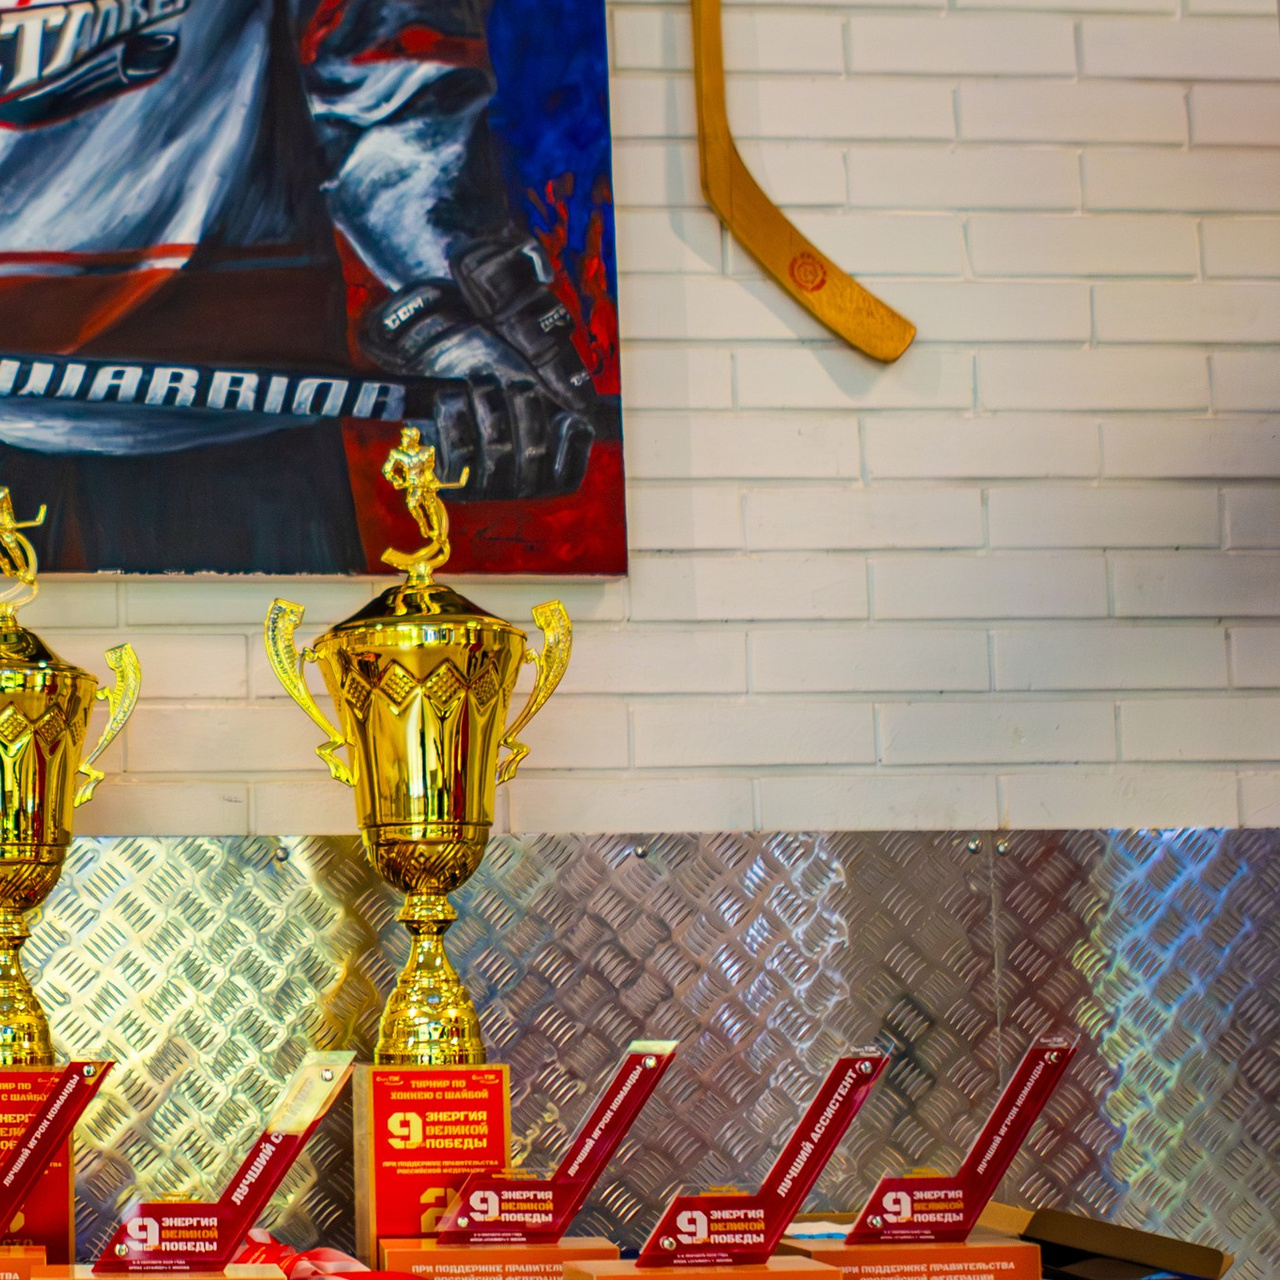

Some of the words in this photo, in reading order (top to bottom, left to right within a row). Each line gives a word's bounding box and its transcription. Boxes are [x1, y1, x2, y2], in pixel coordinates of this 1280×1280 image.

[18, 1082, 32, 1090] ПО
[410, 1080, 450, 1088] ТУРНИР
[452, 1079, 466, 1088] ПО
[390, 1091, 434, 1100] ХОККЕЮ
[444, 1089, 489, 1099] ШАЙБОЙ
[2, 1147, 32, 1187] ЛУЧШИЙ
[27, 1118, 51, 1151] ИГРОК
[45, 1074, 80, 1121] КОМАНДЫ
[387, 1111, 423, 1150] 9
[425, 1110, 488, 1122] ЭНЕРГИЯ
[425, 1122, 489, 1136] ВЕЛИКОЙ
[776, 1139, 815, 1198] ЛУЧШИЙ
[813, 1068, 858, 1144] АССИСТЕНТ
[425, 1137, 488, 1150] ПОБЕДЫ
[230, 1141, 277, 1206] ЛУЧШИЙ
[469, 1190, 500, 1222] 9
[501, 1190, 554, 1200] ЭНЕРГИЯ
[881, 1190, 912, 1224] 9
[913, 1189, 964, 1200] ЭНЕРГИЯ
[501, 1212, 554, 1223] ПОБЕДЫ
[913, 1212, 964, 1223] ПОБЕДЫ
[126, 1217, 160, 1252] 9
[161, 1216, 218, 1227] ЭНЕРГИЯ
[676, 1210, 708, 1245] 9
[709, 1209, 765, 1219] ЭНЕРГИЯ
[709, 1232, 765, 1245] ПОБЕДЫ
[161, 1240, 218, 1253] ПОБЕДЫ
[411, 1264, 433, 1273] ПРИ
[435, 1264, 504, 1274] ПОДДЕРЖКЕ
[860, 1264, 928, 1275] ПОДДЕРЖКЕ
[929, 1261, 1016, 1272] ПРАВИТЕЛЬСТВА
